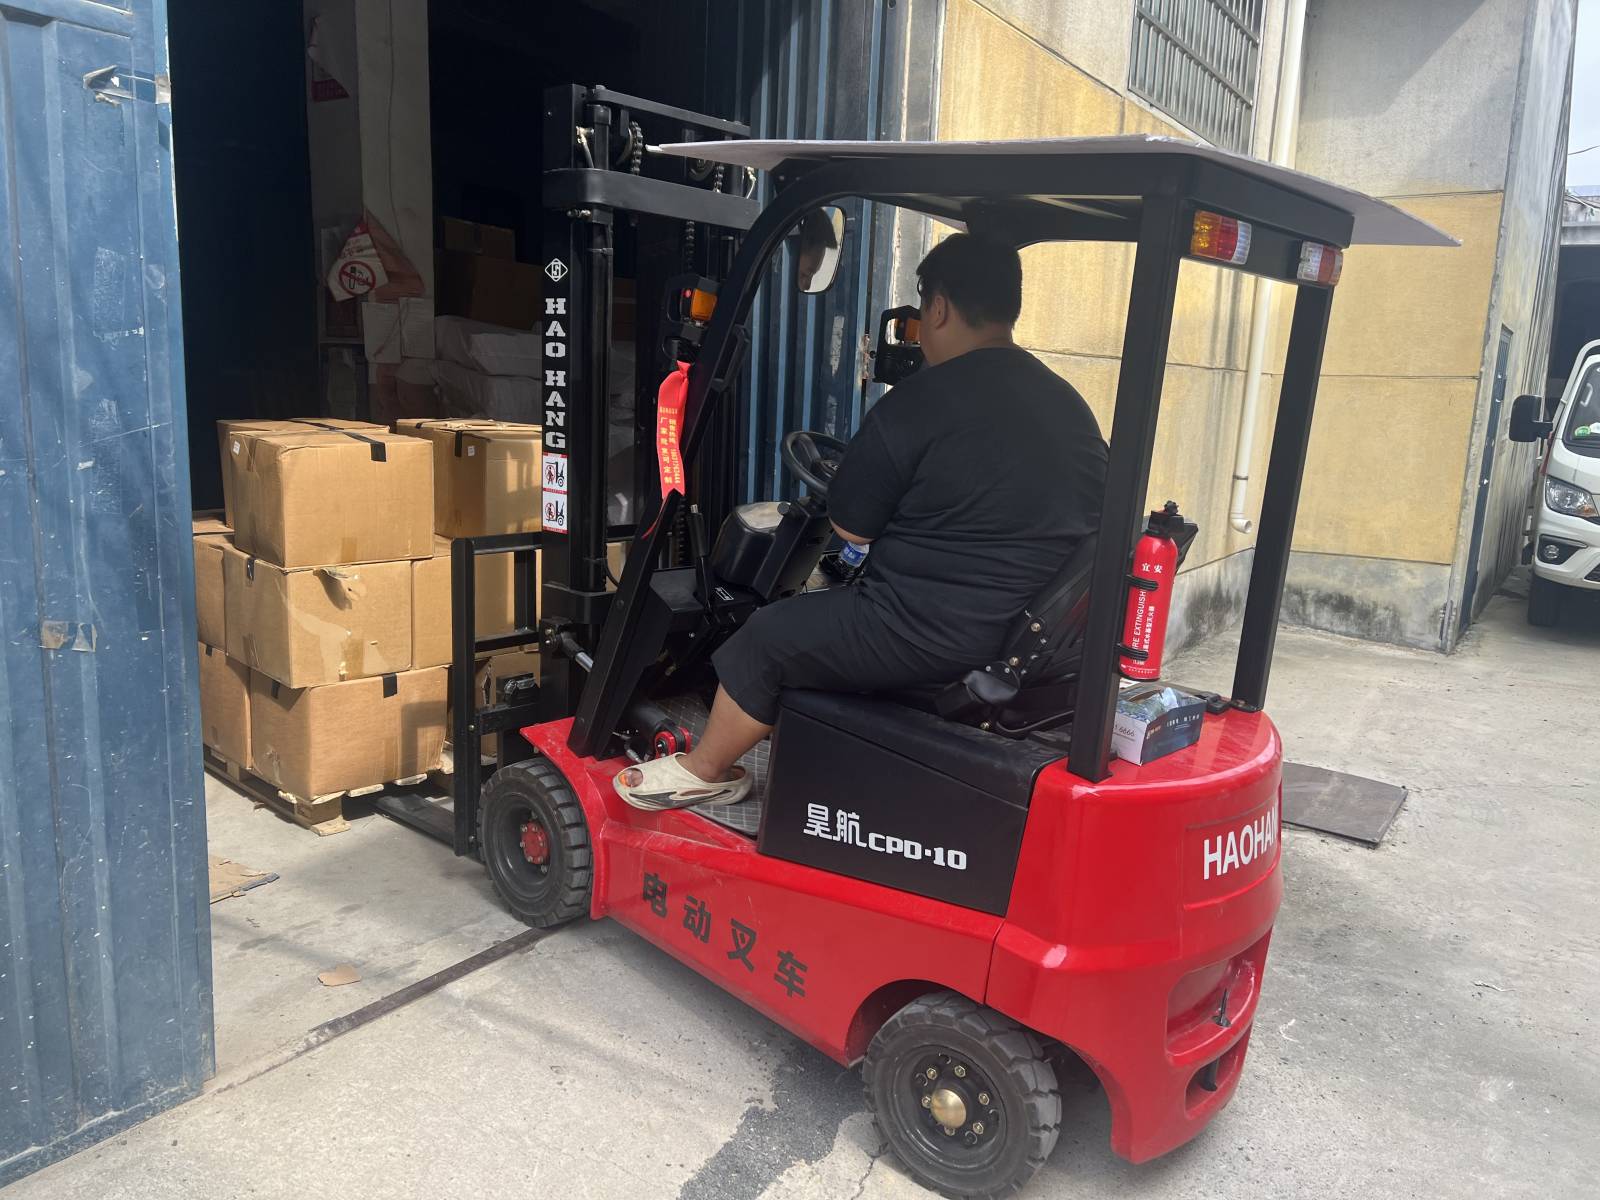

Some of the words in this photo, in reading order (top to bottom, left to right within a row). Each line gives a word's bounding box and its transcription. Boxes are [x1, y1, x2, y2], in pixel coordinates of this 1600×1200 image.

[545, 297, 566, 358] HAO
[545, 370, 566, 449] HANG
[1134, 590, 1147, 635] EXTINGUISH
[1203, 803, 1278, 880] HAOHAN
[642, 872, 808, 998] 电动叉车
